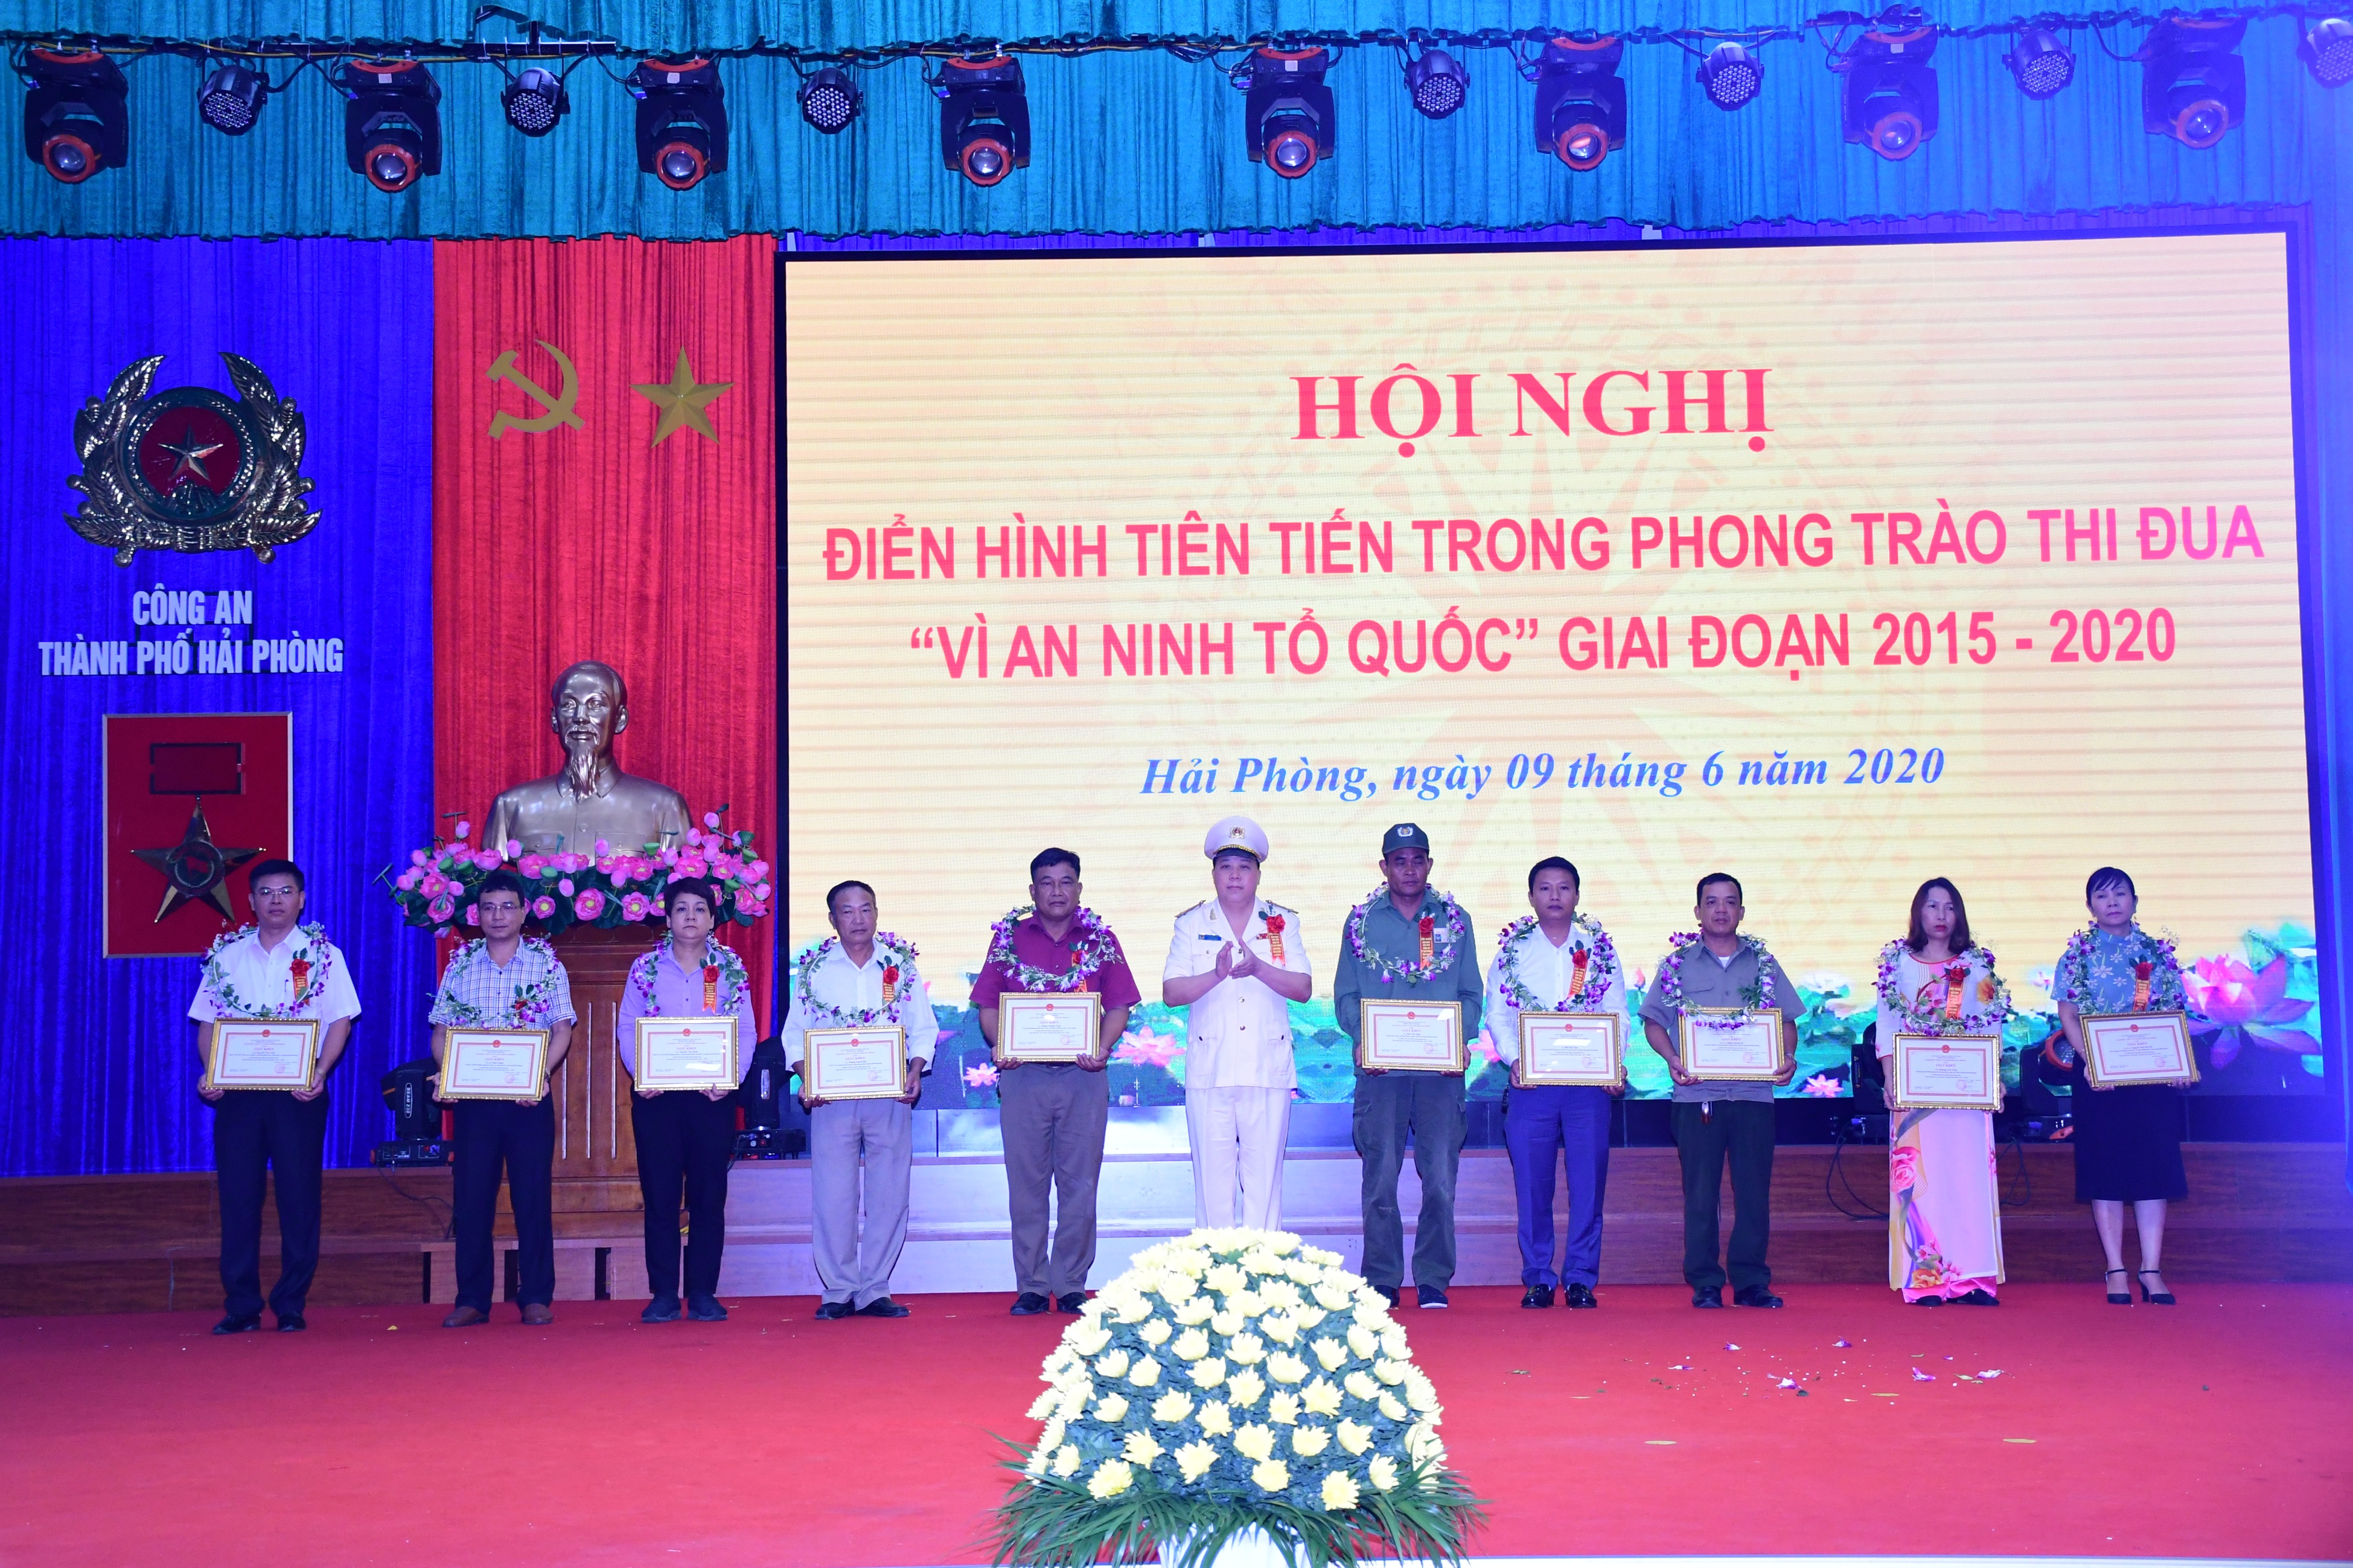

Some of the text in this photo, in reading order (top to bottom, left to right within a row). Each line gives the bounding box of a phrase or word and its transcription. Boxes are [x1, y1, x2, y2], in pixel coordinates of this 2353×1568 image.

[1290, 363, 1774, 458] HỘI NGHỊ
[822, 498, 2265, 581] ĐIỂN HÌNH TIÊN TIẾN TRONG PHONG TRÀO THI ĐUA
[133, 583, 252, 625] CÔNG AN
[38, 628, 343, 676] THÀNH PHỐ HẢI PHÒNG
[911, 605, 2176, 681] “VÌ AN NINH TỔ QUỐC” GIAI ĐOẠN 2015 - 2020
[1139, 747, 1945, 802] Hải Phòng, ngày 09 tháng 6 năm 2020
